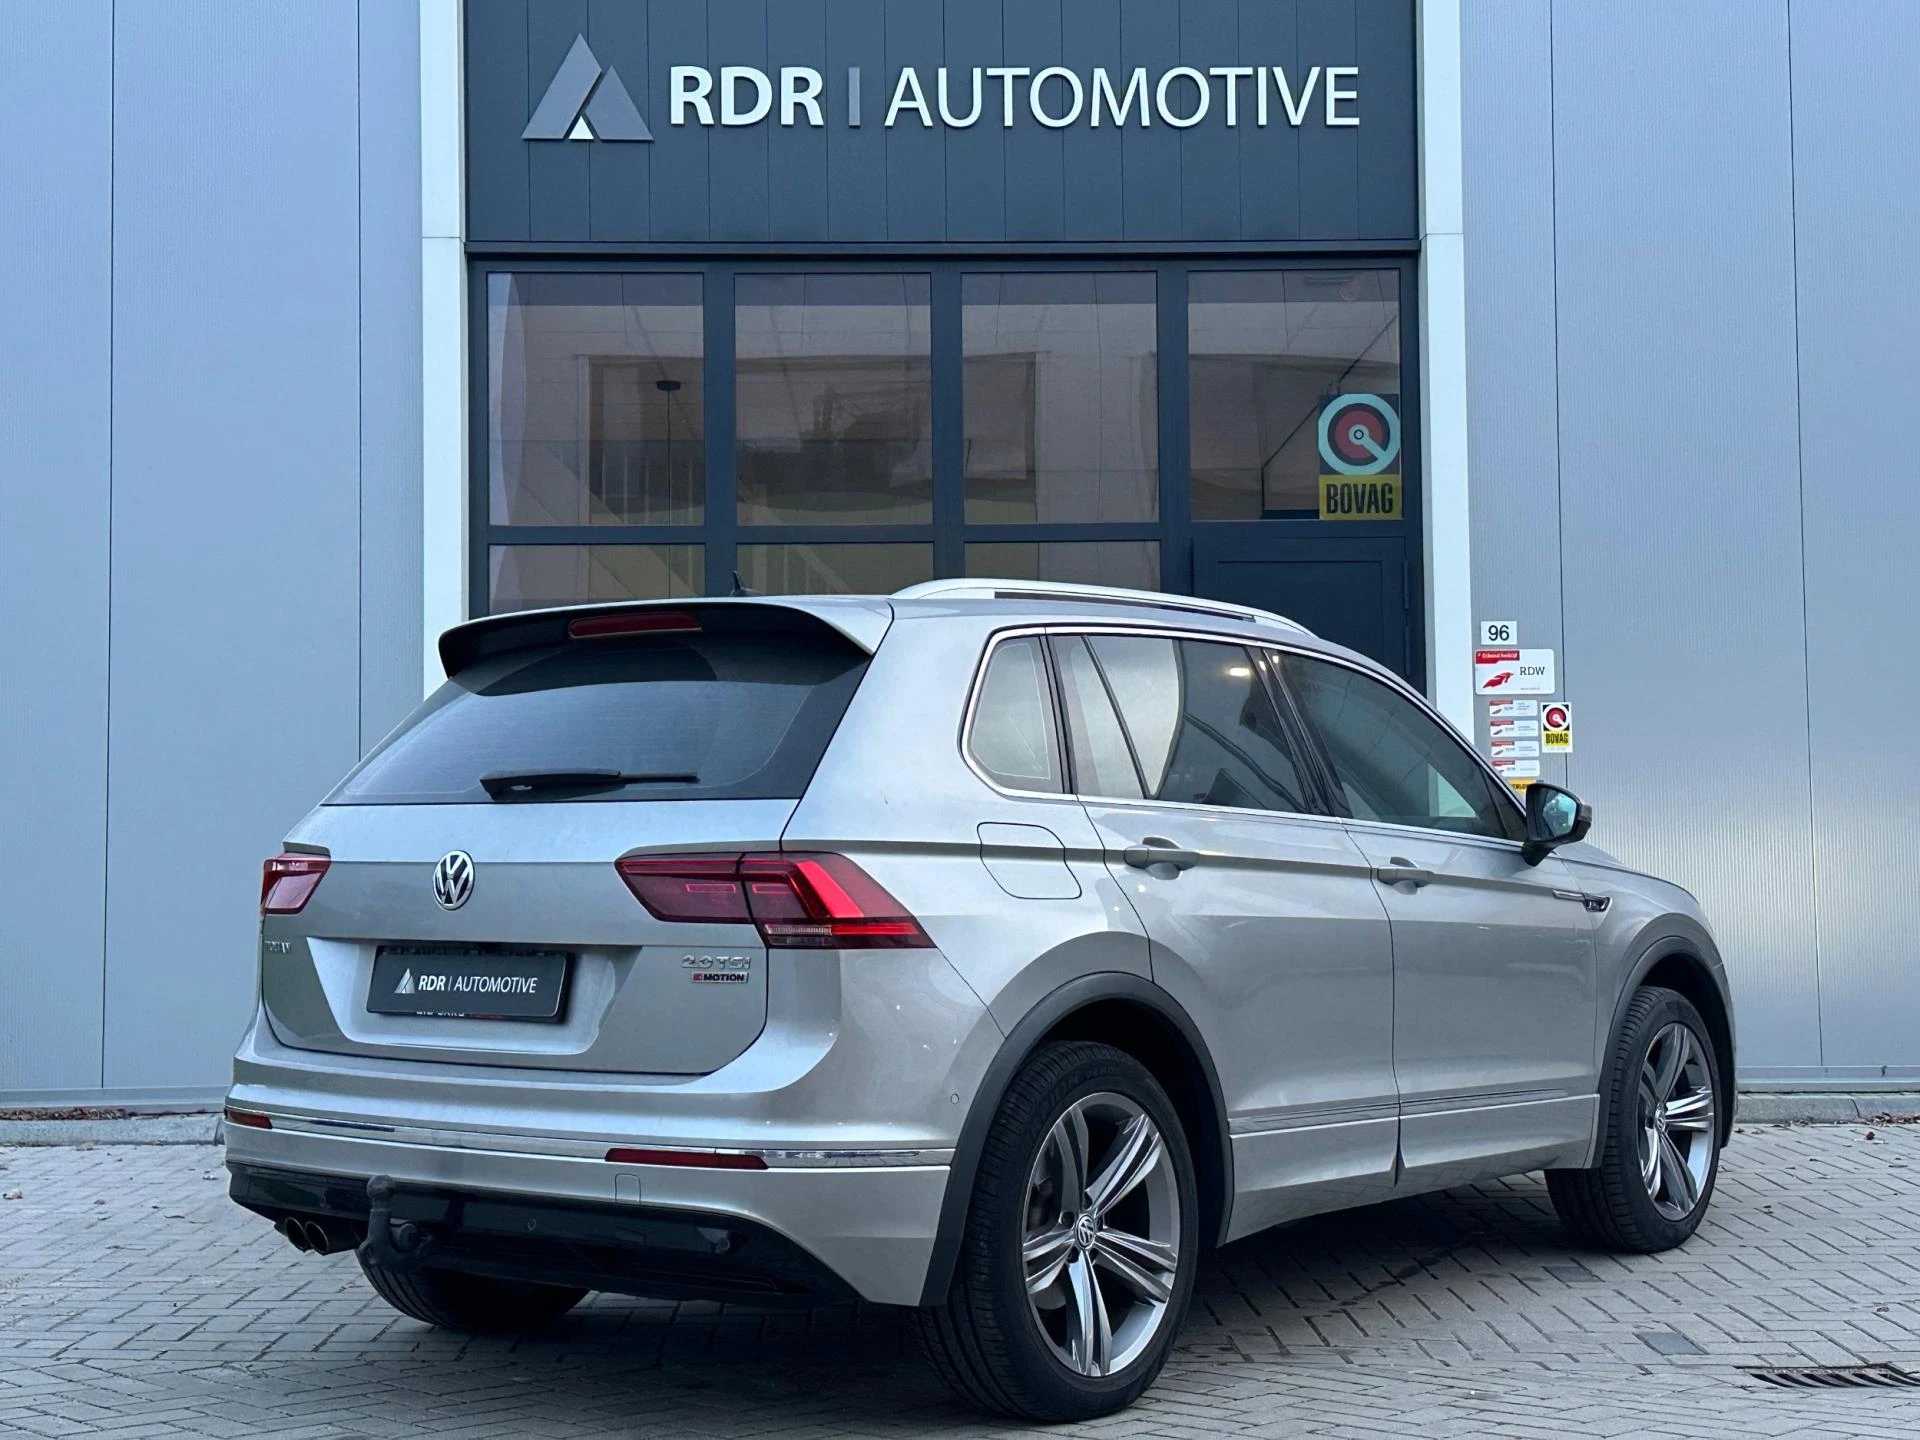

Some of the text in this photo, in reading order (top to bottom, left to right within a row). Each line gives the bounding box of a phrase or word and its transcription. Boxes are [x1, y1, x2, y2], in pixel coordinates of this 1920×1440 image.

[669, 65, 825, 127] RDR
[884, 66, 1361, 128] AUTOMOTIVE
[1326, 482, 1394, 514] BOVAG
[1488, 624, 1510, 641] 96
[1519, 666, 1545, 676] RDW
[1545, 733, 1569, 744] BOVAG
[715, 956, 751, 969] TSI
[418, 975, 447, 992] RDR
[453, 975, 538, 993] AUTOMOTIVE
